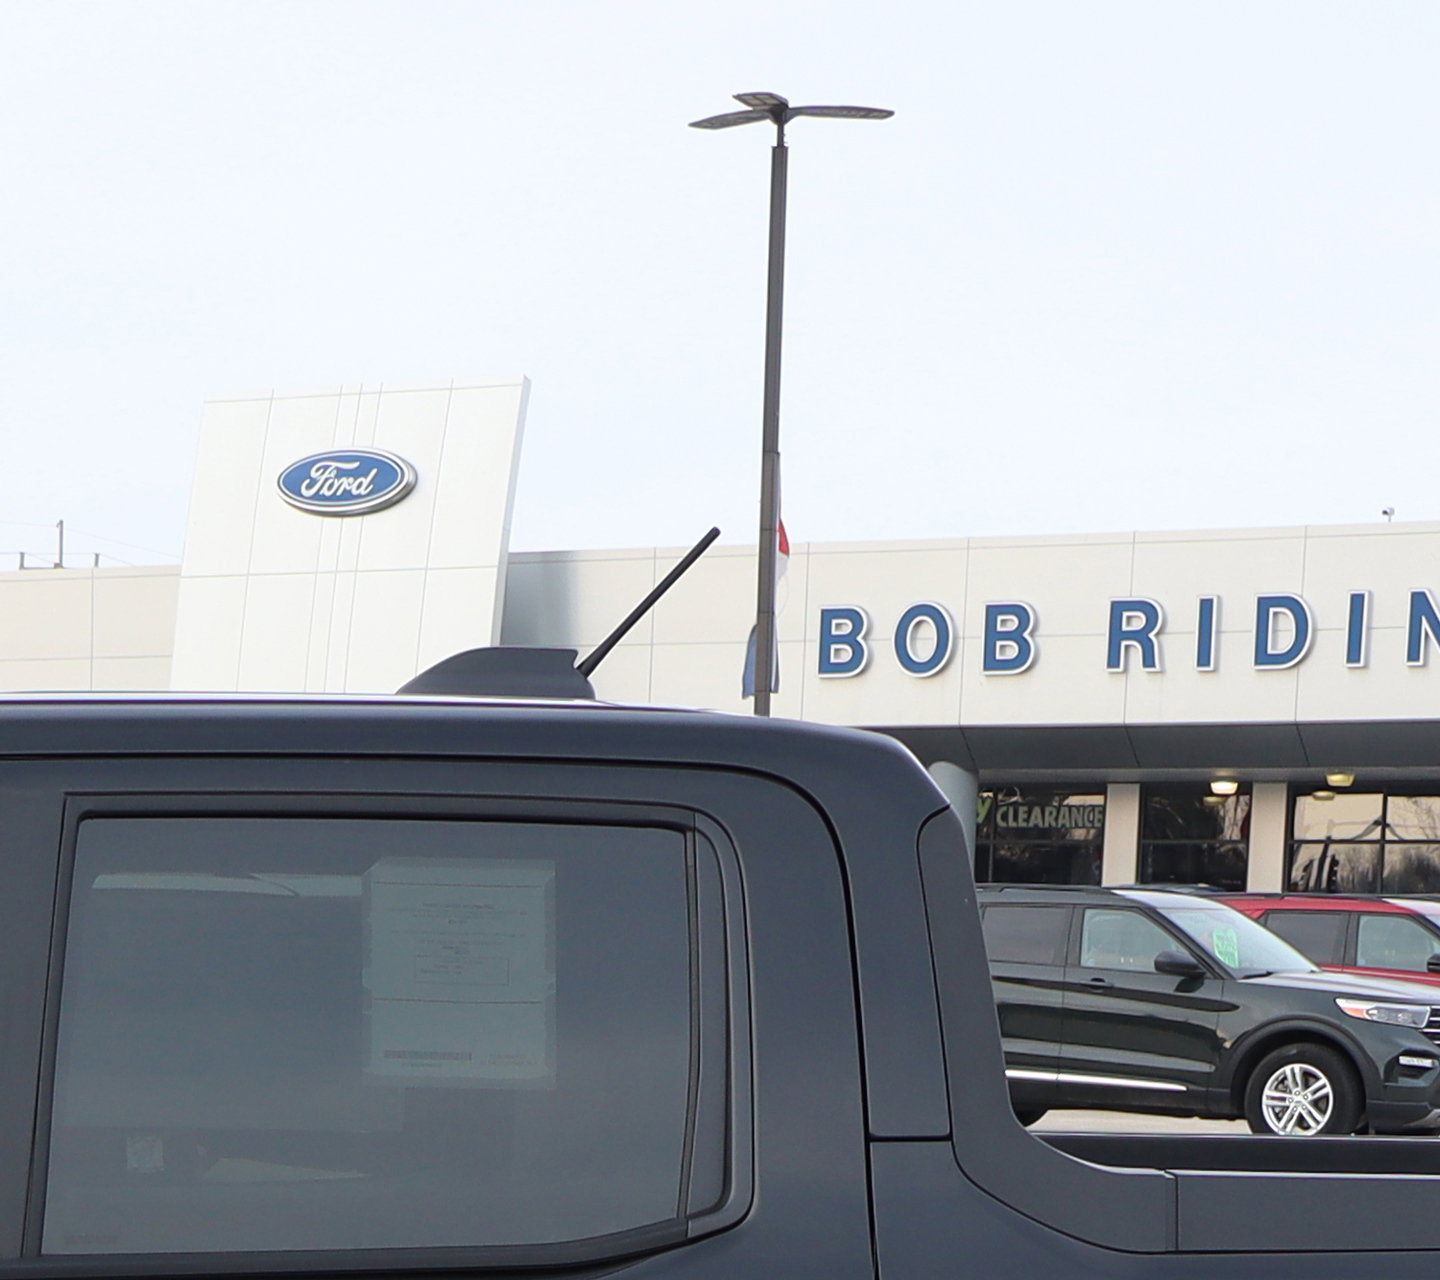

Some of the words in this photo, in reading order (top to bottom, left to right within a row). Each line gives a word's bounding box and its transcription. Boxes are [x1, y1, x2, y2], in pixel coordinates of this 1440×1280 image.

[300, 460, 379, 498] Ford
[817, 601, 1038, 678] BOB
[996, 805, 1104, 828] CLEARANCE
